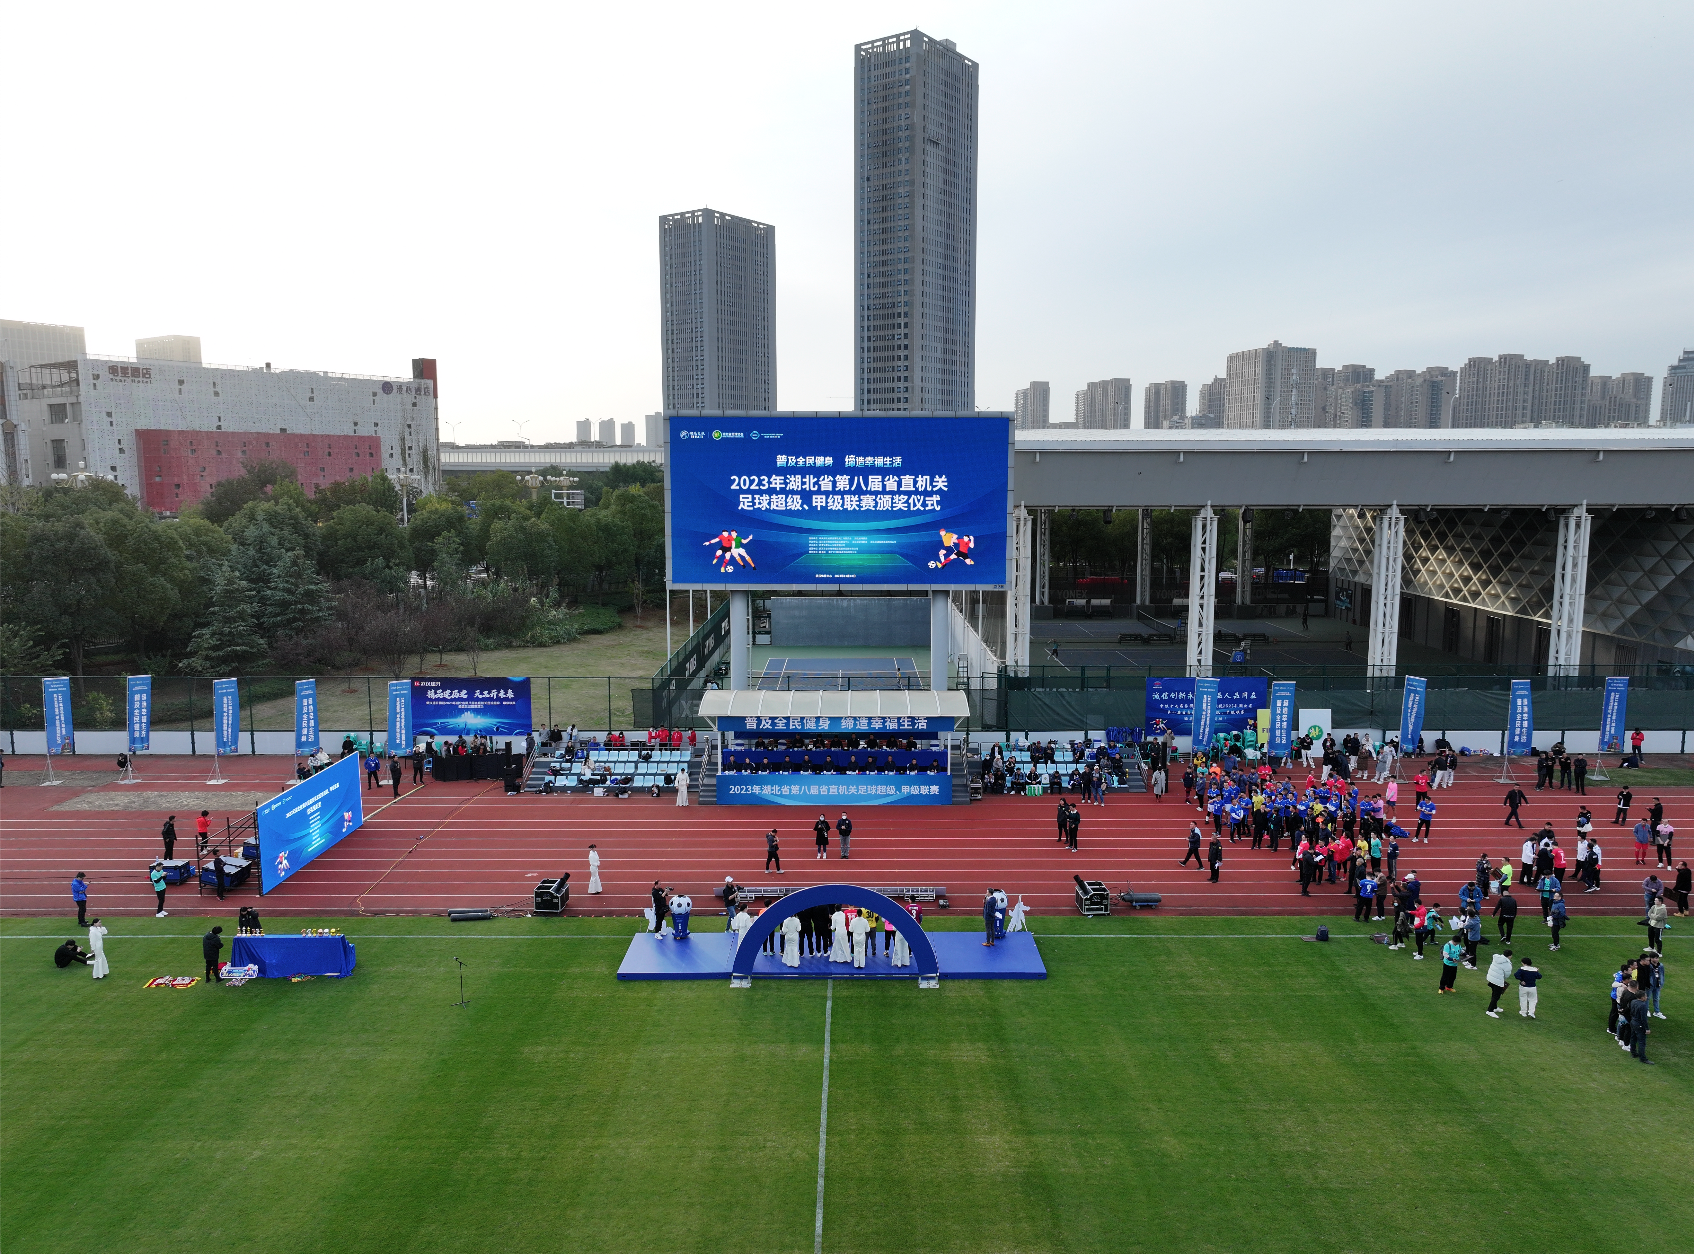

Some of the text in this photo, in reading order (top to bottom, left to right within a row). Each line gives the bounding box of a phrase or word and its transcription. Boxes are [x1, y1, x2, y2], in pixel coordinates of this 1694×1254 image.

[776, 455, 903, 468] 普及全民健身 缔造幸福生活
[730, 475, 948, 492] 2023年湖北省第八届省直机关
[738, 494, 941, 511] 足球超级、甲级联赛颁奖仪式
[744, 716, 928, 730] 普及全民健身 缔造幸福生活
[729, 784, 940, 795] 2023年湖北省第八届省直机关足球超级、甲级联赛
